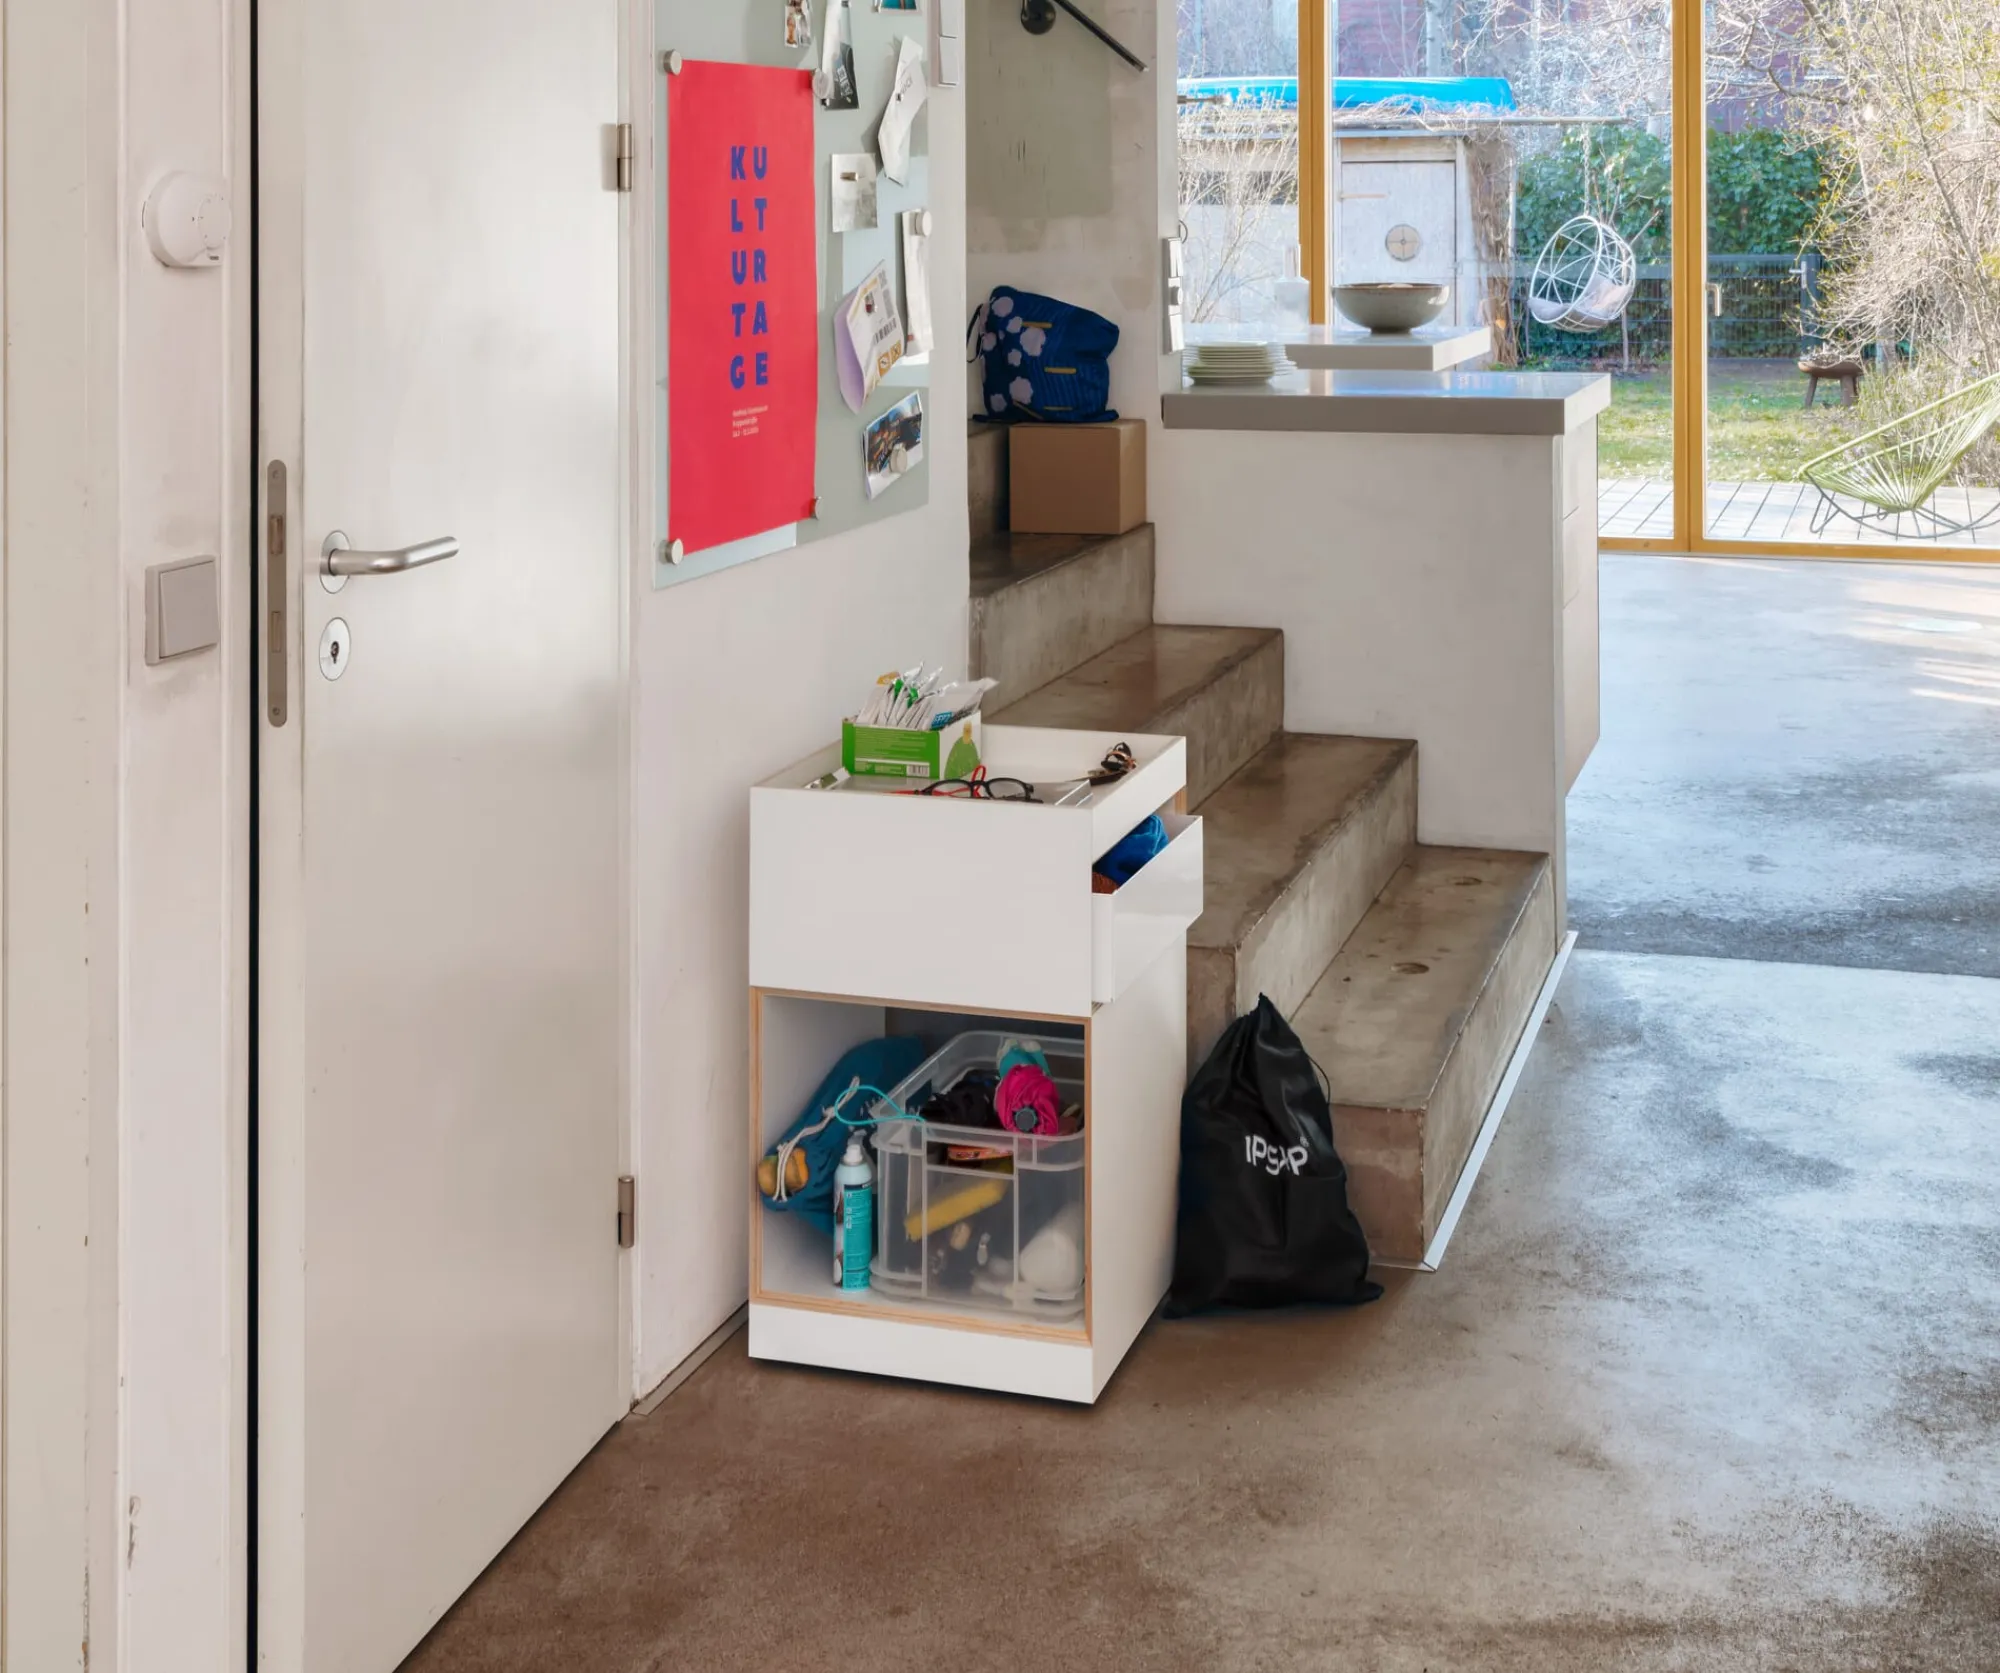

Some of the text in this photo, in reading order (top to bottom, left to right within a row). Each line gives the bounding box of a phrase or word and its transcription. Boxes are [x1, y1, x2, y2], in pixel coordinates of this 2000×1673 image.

[731, 145, 767, 181] KU
[731, 198, 767, 232] LT
[731, 248, 767, 285] UR
[731, 301, 768, 338] TA
[730, 352, 768, 390] GE
